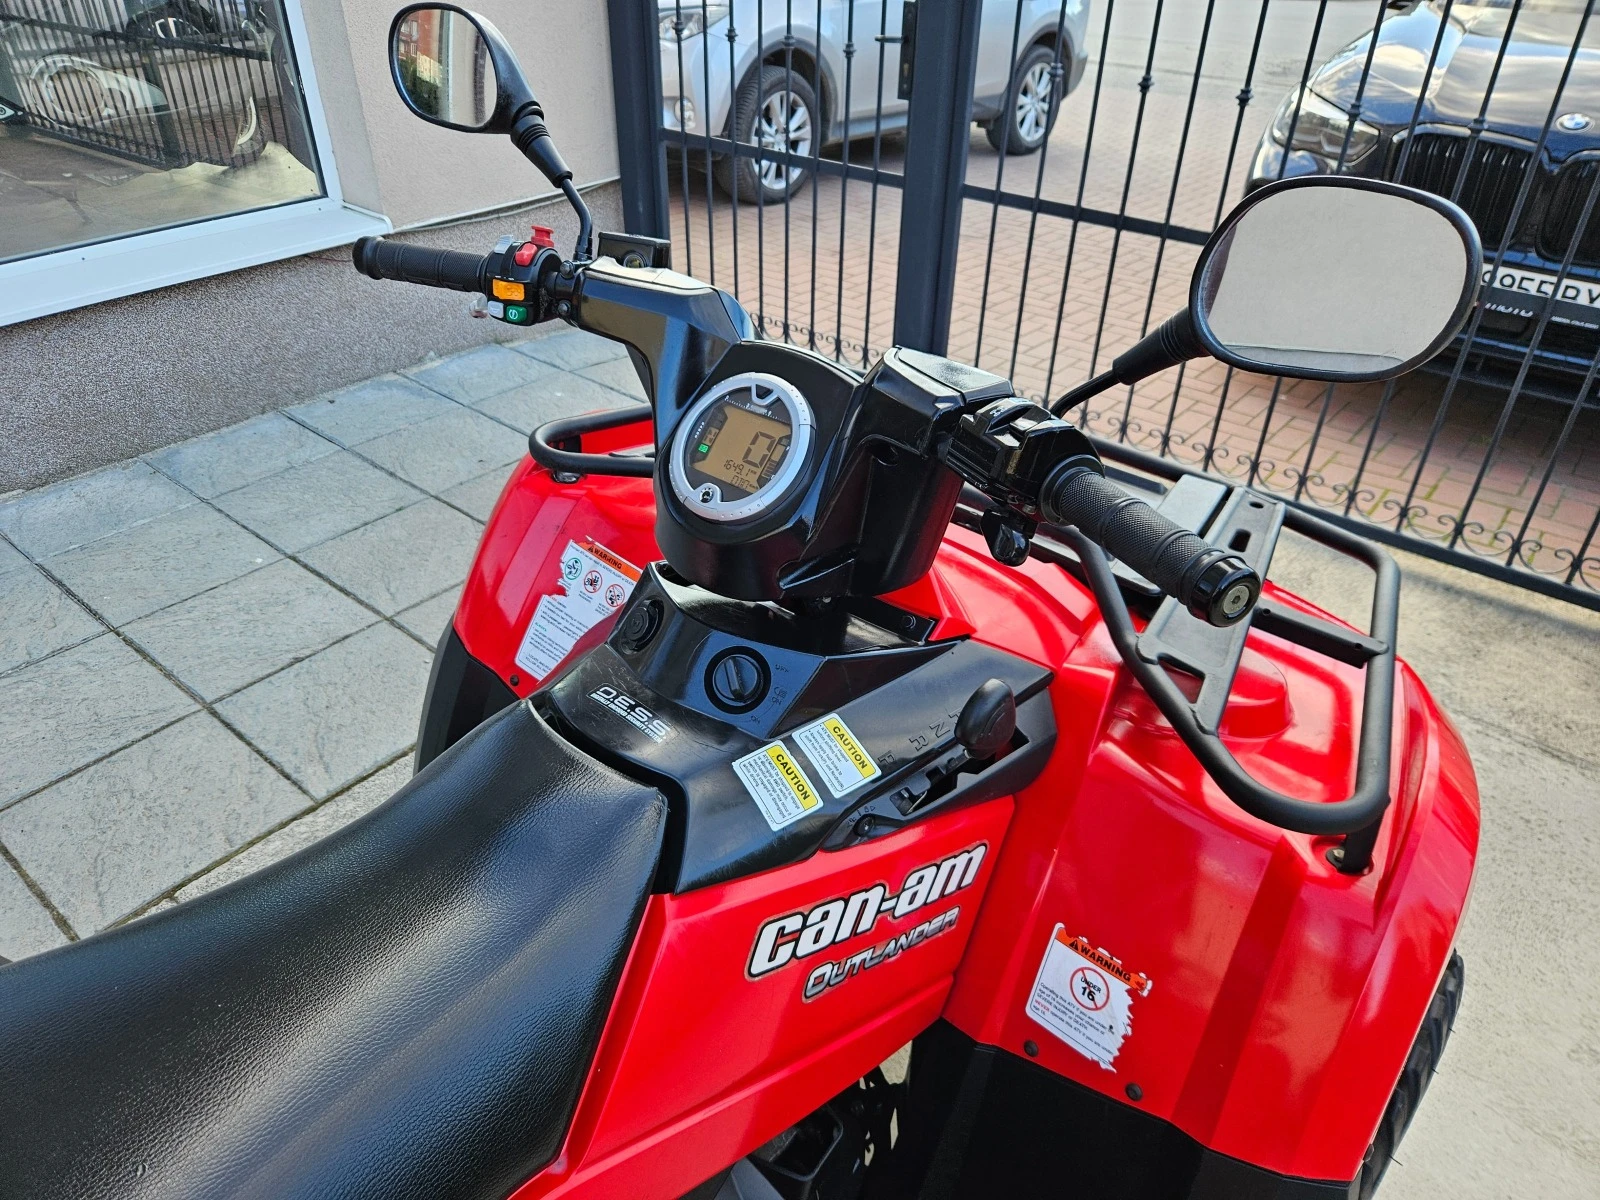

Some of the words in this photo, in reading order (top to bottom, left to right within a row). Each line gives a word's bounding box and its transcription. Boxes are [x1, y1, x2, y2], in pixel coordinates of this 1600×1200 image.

[742, 431, 777, 469] 0
[594, 548, 622, 569] WARNING
[623, 714, 647, 731] SECURITY
[642, 727, 663, 743] SYSTEM
[833, 726, 867, 769] CAUTION
[776, 754, 811, 800] CAUTION
[804, 905, 960, 1000] OUTLANDER
[1080, 945, 1131, 982] WARNING
[1080, 976, 1101, 993] UNDER
[1081, 986, 1096, 1002] 16
[1034, 999, 1049, 1012] NEVER
[1073, 1025, 1081, 1034] ATV
[1067, 1000, 1075, 1008] ATV
[1079, 1009, 1087, 1017] you
[1074, 1013, 1084, 1022] your
